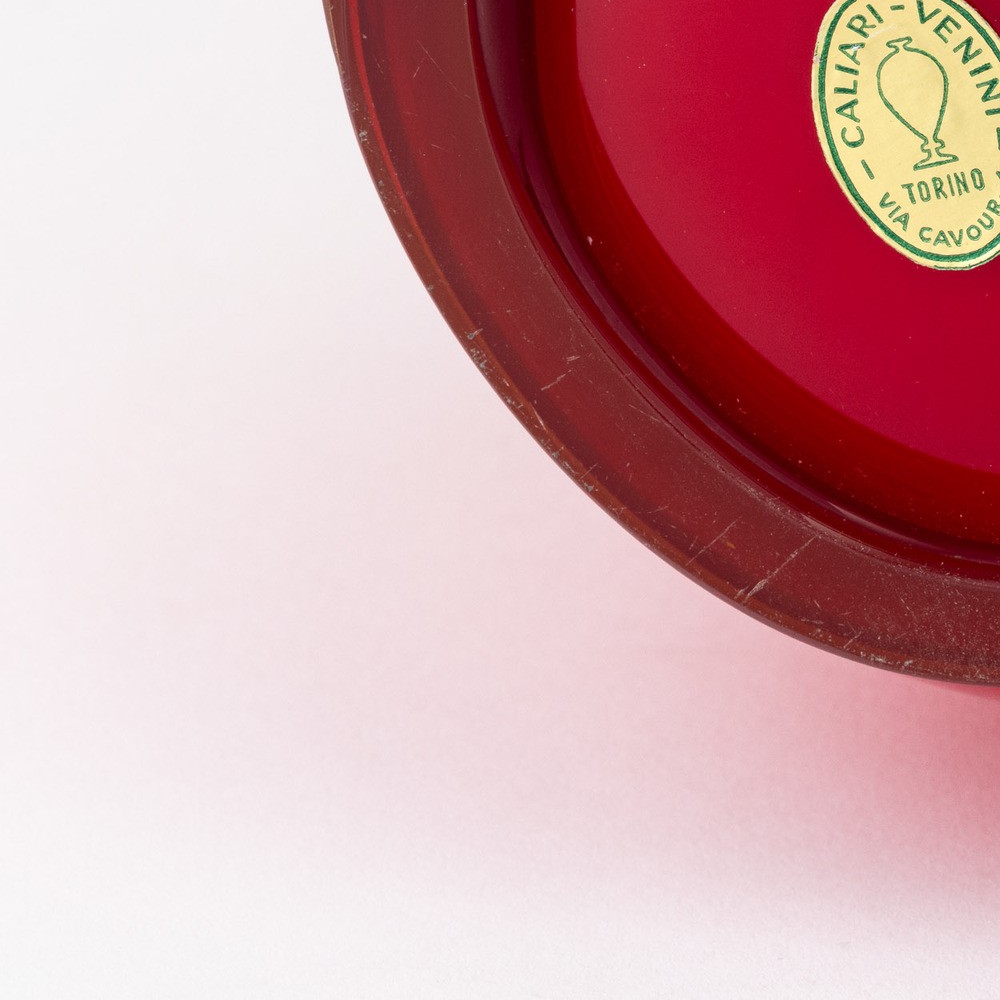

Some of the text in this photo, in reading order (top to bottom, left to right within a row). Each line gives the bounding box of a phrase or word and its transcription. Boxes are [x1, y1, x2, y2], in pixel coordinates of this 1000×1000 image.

[833, 3, 884, 149] CALIARI
[901, 168, 986, 204] TORINO
[878, 192, 912, 231] VIA
